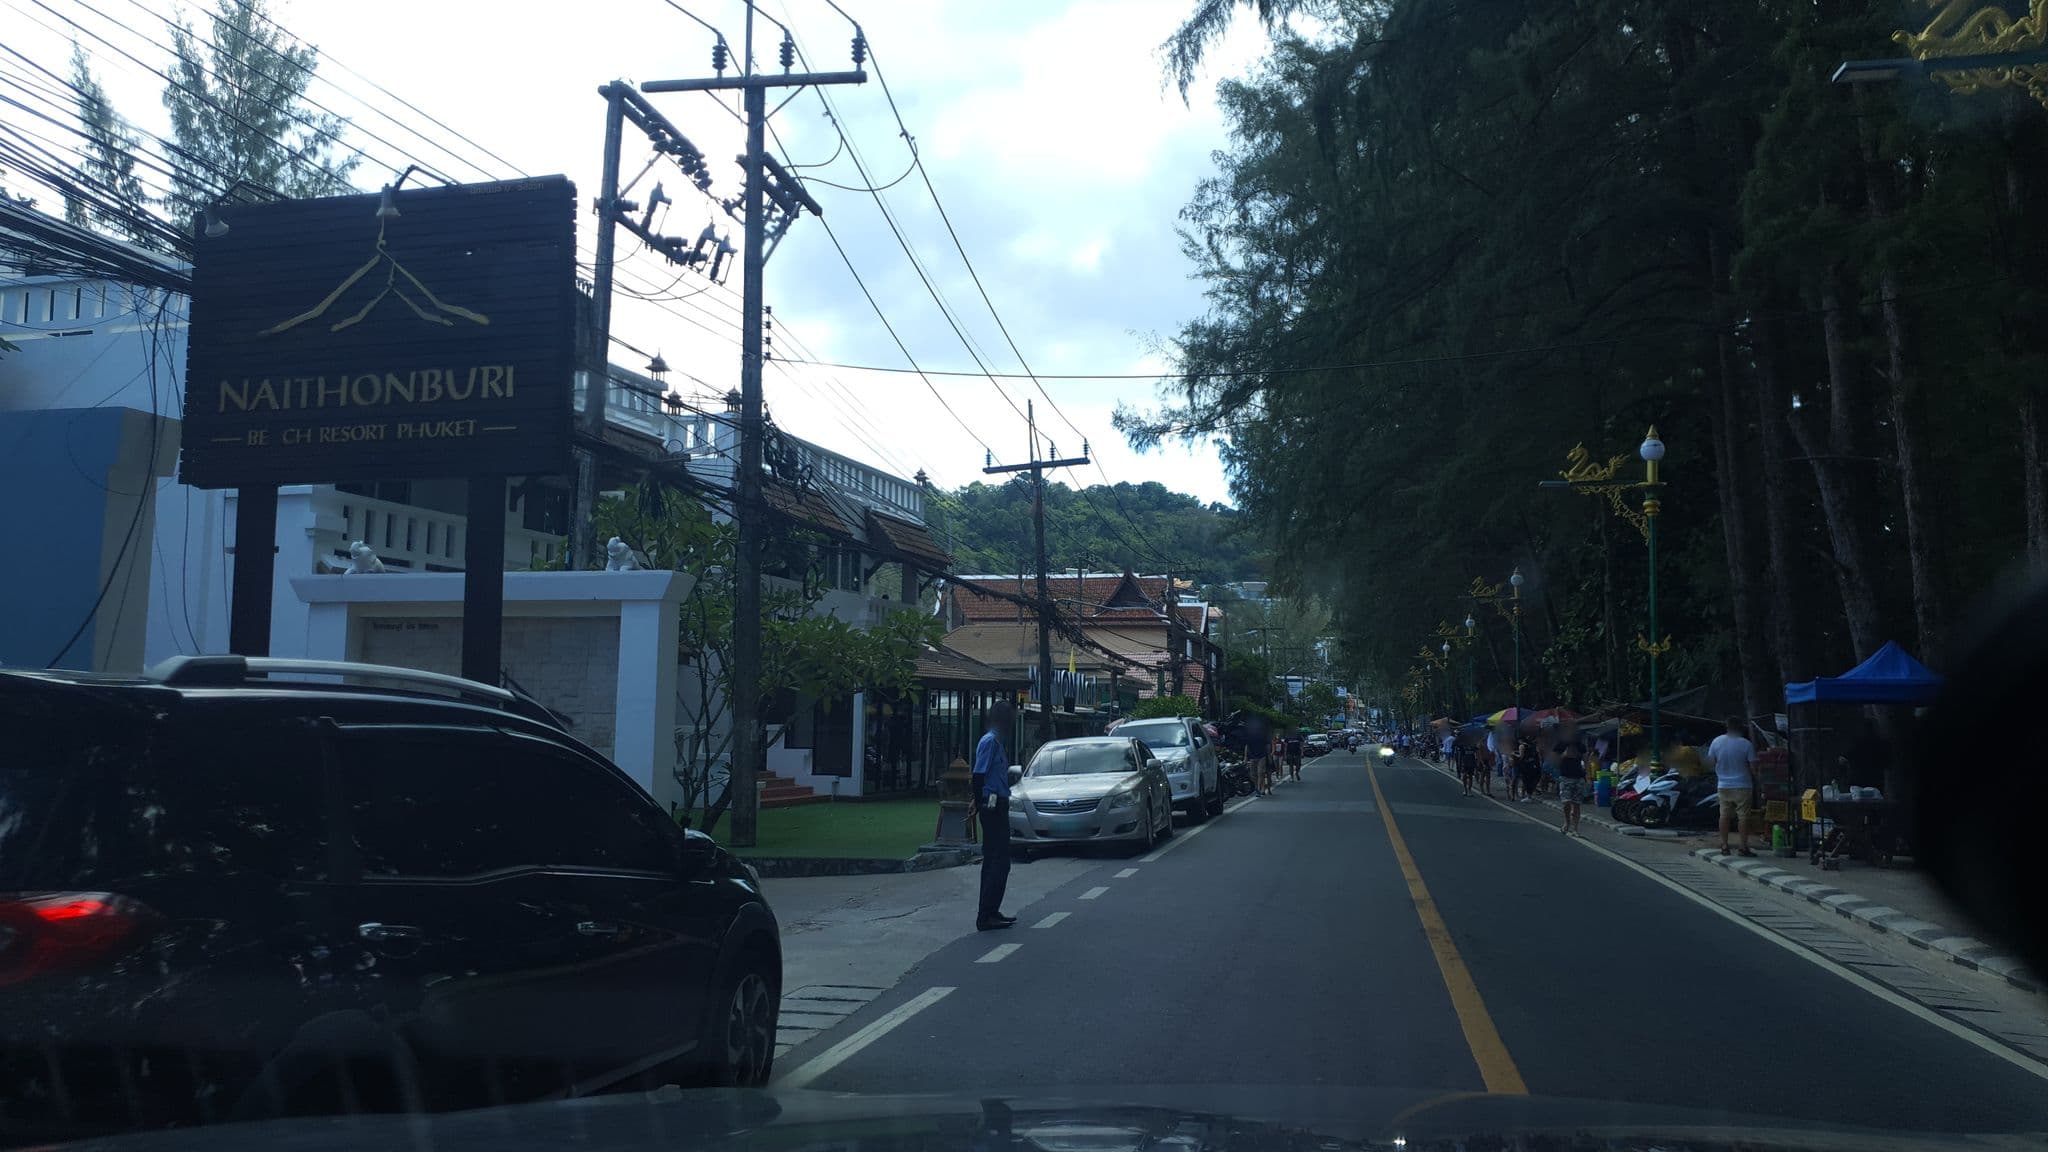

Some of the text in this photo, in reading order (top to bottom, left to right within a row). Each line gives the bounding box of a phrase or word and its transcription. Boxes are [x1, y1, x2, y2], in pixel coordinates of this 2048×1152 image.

[219, 364, 515, 412] NAITHONBURI
[320, 424, 388, 443] RESORT
[397, 419, 477, 439] PHUKET
